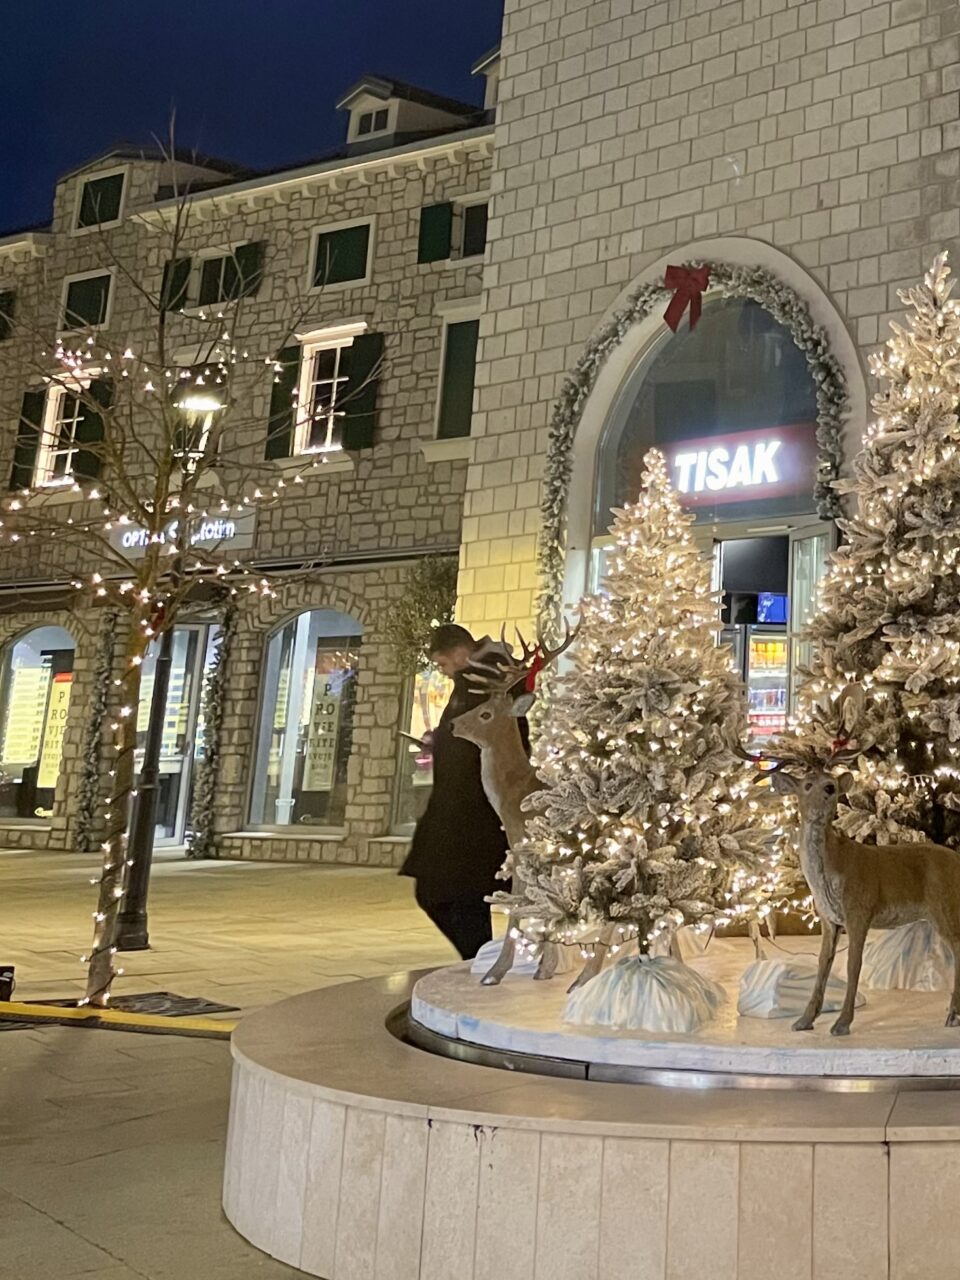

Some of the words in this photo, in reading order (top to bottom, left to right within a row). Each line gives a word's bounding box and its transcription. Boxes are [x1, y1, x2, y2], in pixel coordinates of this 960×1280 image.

[673, 439, 783, 495] TISAK
[58, 691, 65, 703] P
[51, 709, 67, 720] RO
